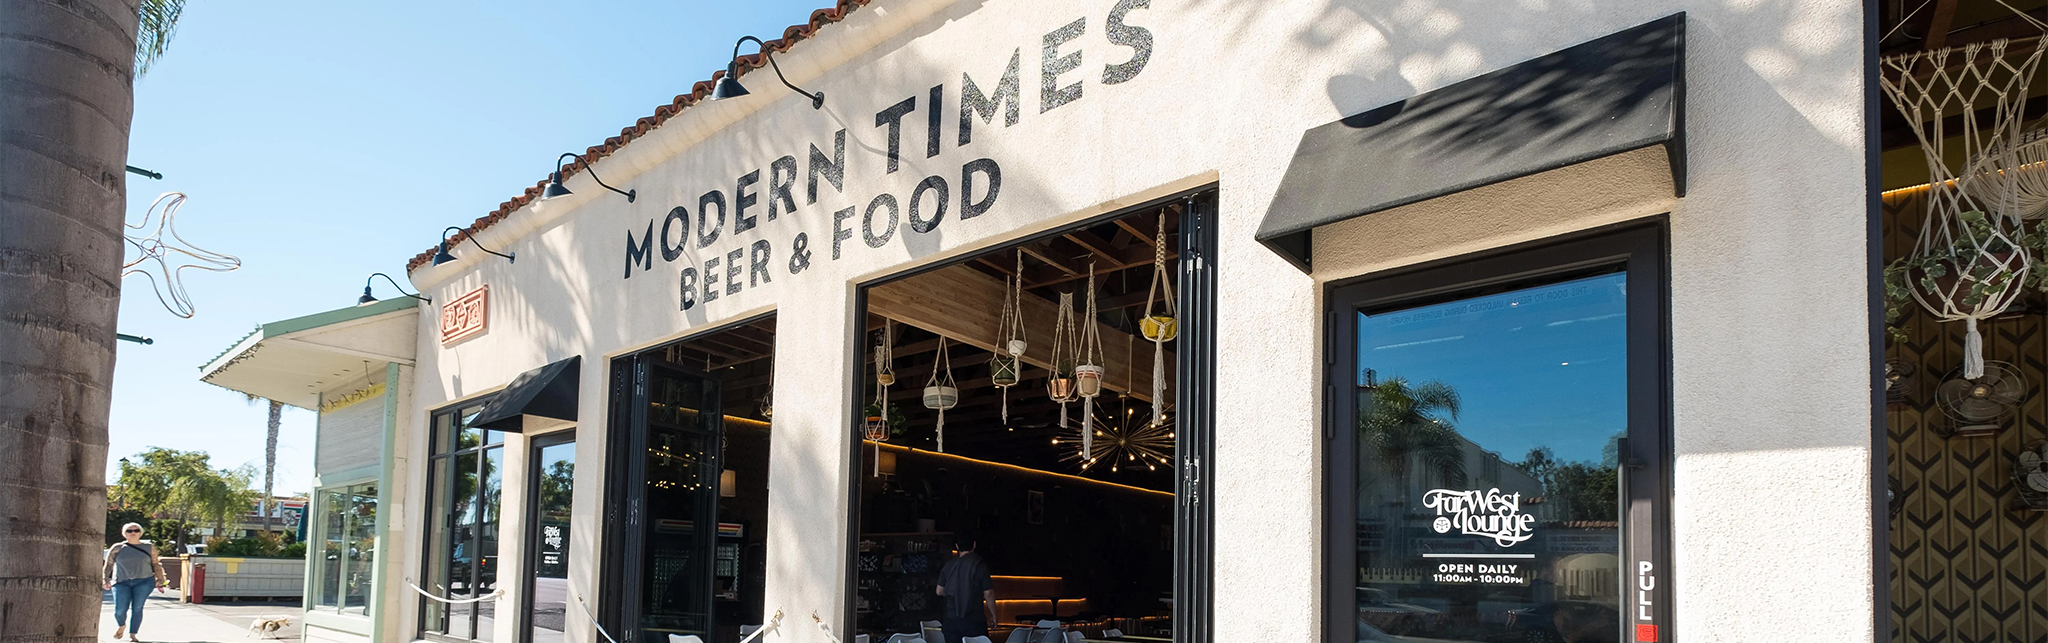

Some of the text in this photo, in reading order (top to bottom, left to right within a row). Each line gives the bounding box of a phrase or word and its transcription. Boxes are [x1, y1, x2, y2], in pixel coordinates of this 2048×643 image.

[625, 0, 1153, 279] MODERN TIMES
[680, 157, 1001, 311] BEER & FOOD
[1453, 507, 1535, 547] Lounge
[1433, 574, 1472, 583] 11:00AM
[1479, 575, 1523, 584] 10:00PM
[1438, 564, 1517, 574] OPEN DAILY
[1639, 561, 1655, 620] PULL
